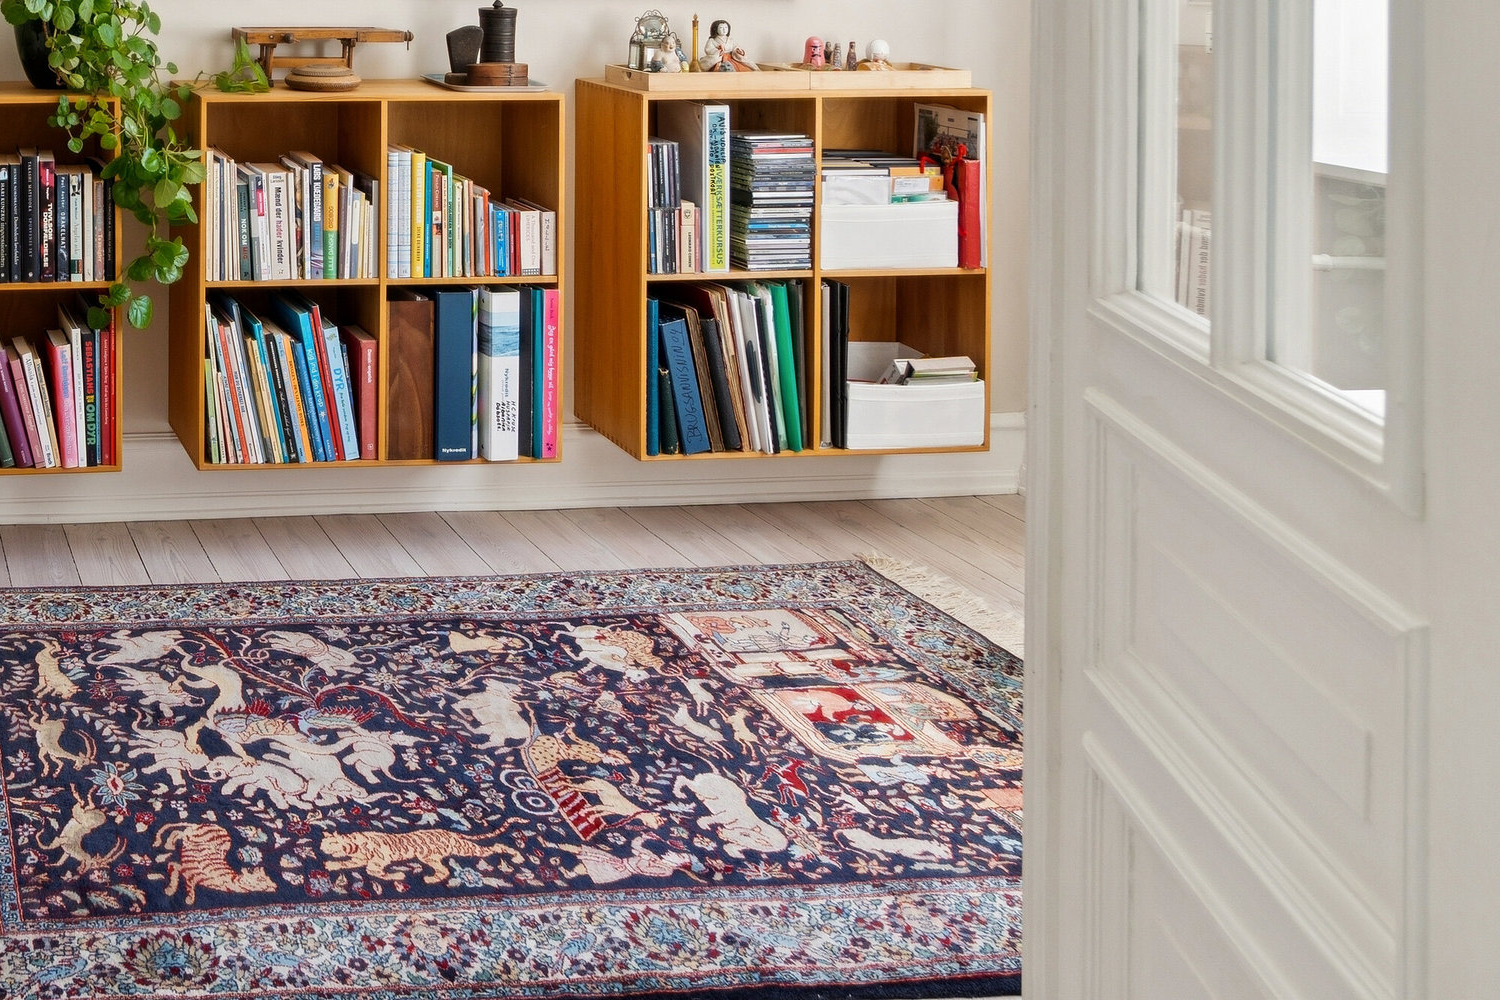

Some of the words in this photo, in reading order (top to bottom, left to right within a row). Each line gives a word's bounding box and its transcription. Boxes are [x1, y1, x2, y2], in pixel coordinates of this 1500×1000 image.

[313, 164, 322, 181] LARS
[275, 207, 283, 219] der
[716, 168, 724, 265] IVÆRKSÆTTERKURSUS
[242, 234, 248, 246] OM
[275, 220, 283, 239] hader
[276, 240, 284, 264] kvinder
[85, 341, 94, 394] SEBASTIANS
[333, 368, 344, 391] DYR
[86, 403, 95, 422] OM
[87, 422, 96, 446] DYR
